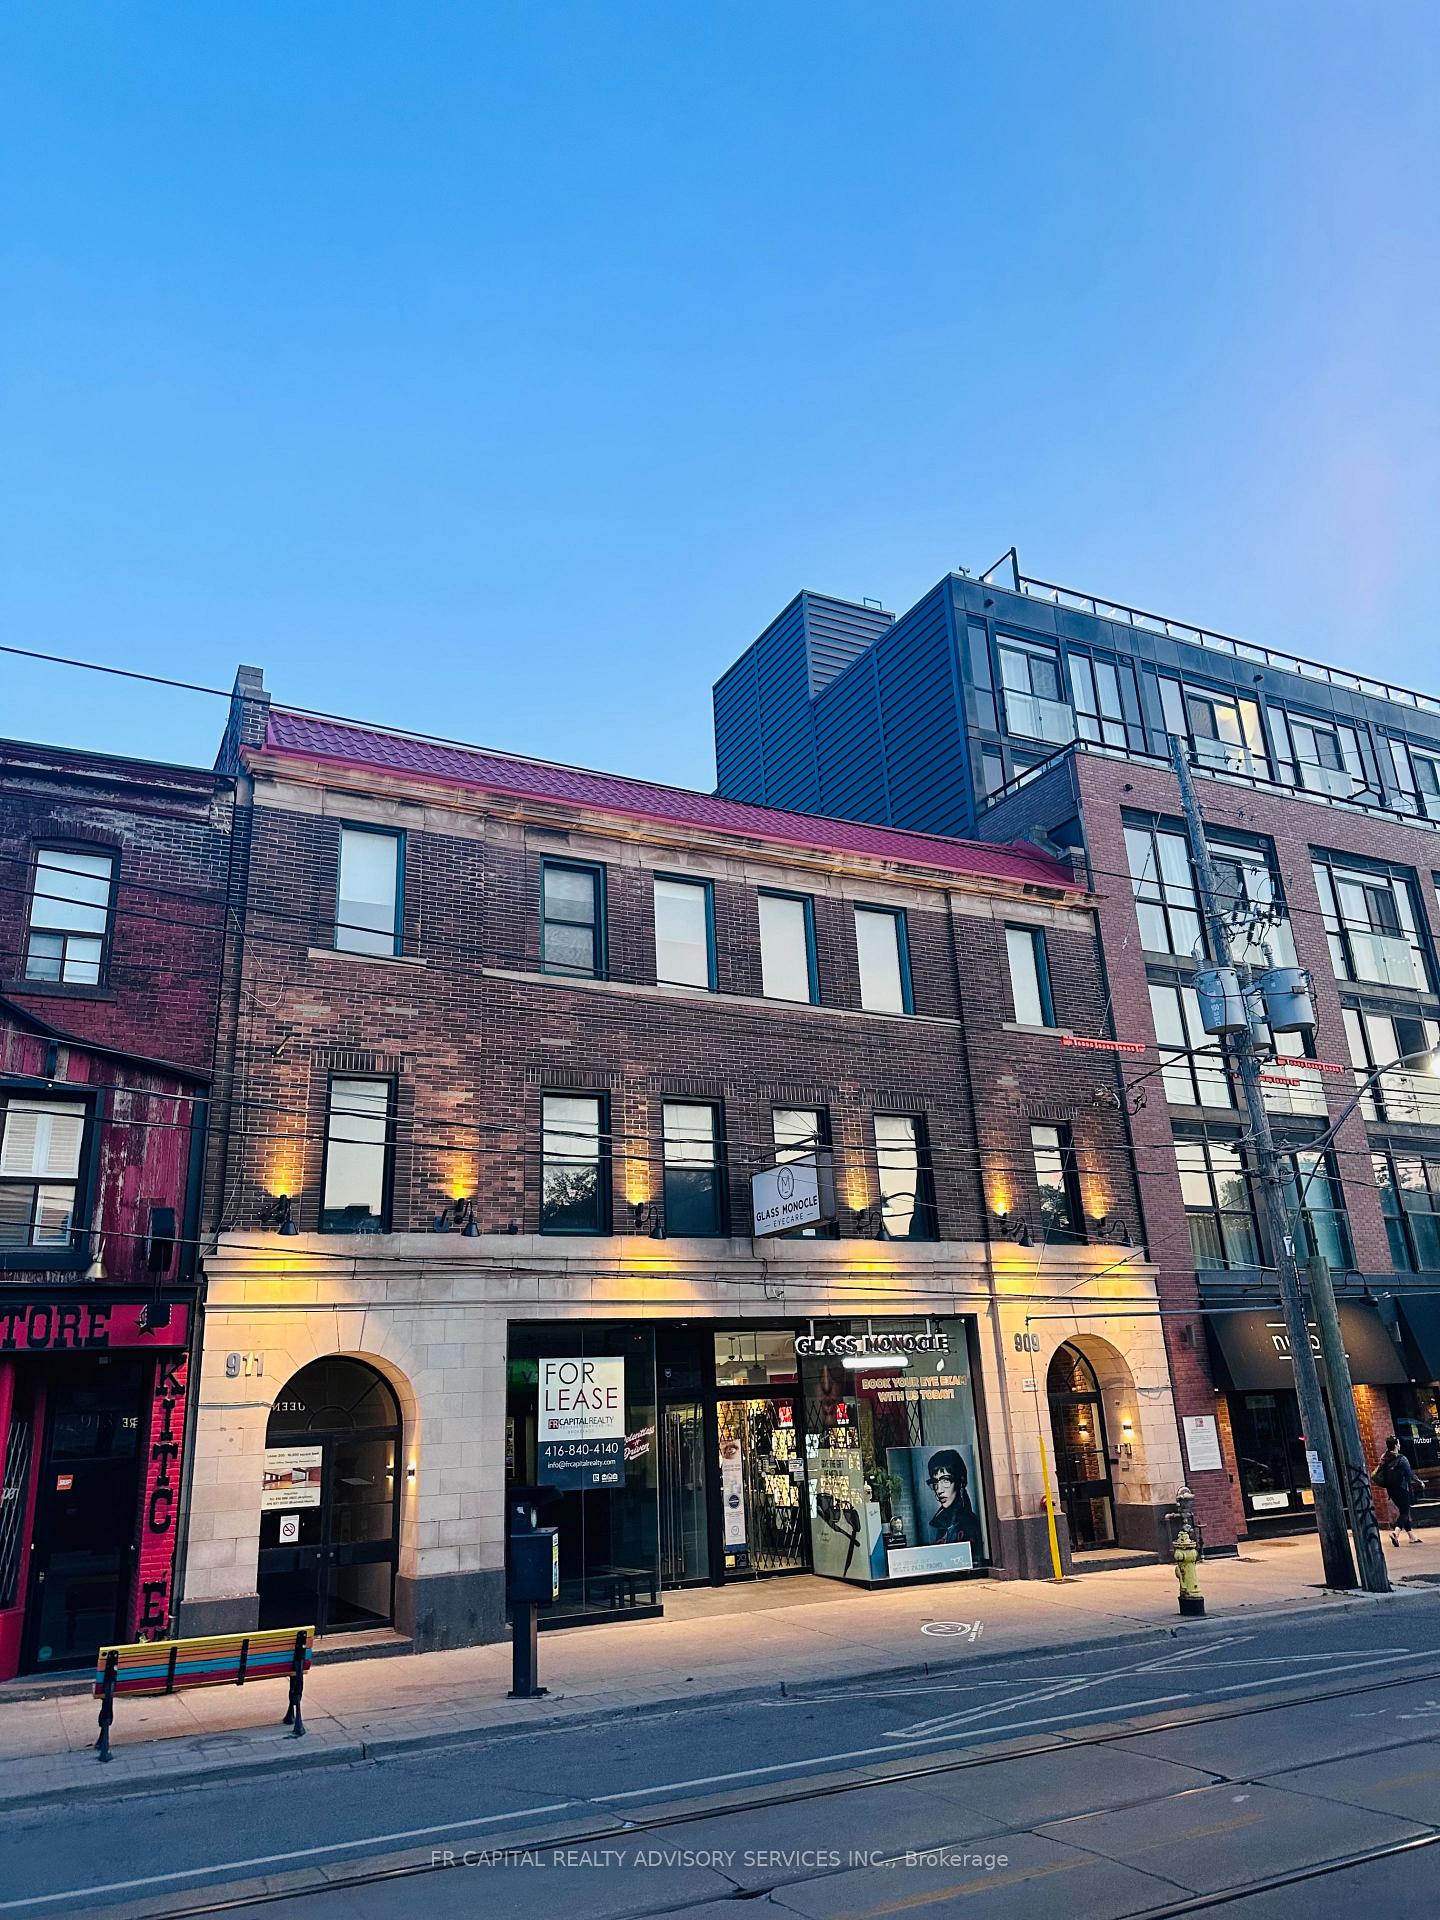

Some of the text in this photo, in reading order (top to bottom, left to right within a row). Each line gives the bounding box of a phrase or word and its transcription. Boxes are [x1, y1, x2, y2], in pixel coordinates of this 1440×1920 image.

[756, 1195, 818, 1222] GLASS MONOCLE
[773, 1212, 804, 1228] EYECARE
[795, 1333, 950, 1356] GLASS MONOCLE
[1014, 1332, 1040, 1352] 909
[225, 1352, 264, 1378] 911
[545, 1362, 595, 1385] FOR
[861, 1375, 967, 1390] BOOK YOUR EYE EXAM
[545, 1387, 618, 1412] LEASE
[877, 1389, 954, 1402] WITH US TODAY!
[545, 1442, 618, 1457] 416-840-4140
[547, 1459, 616, 1470] info@frcapitalrealty.com
